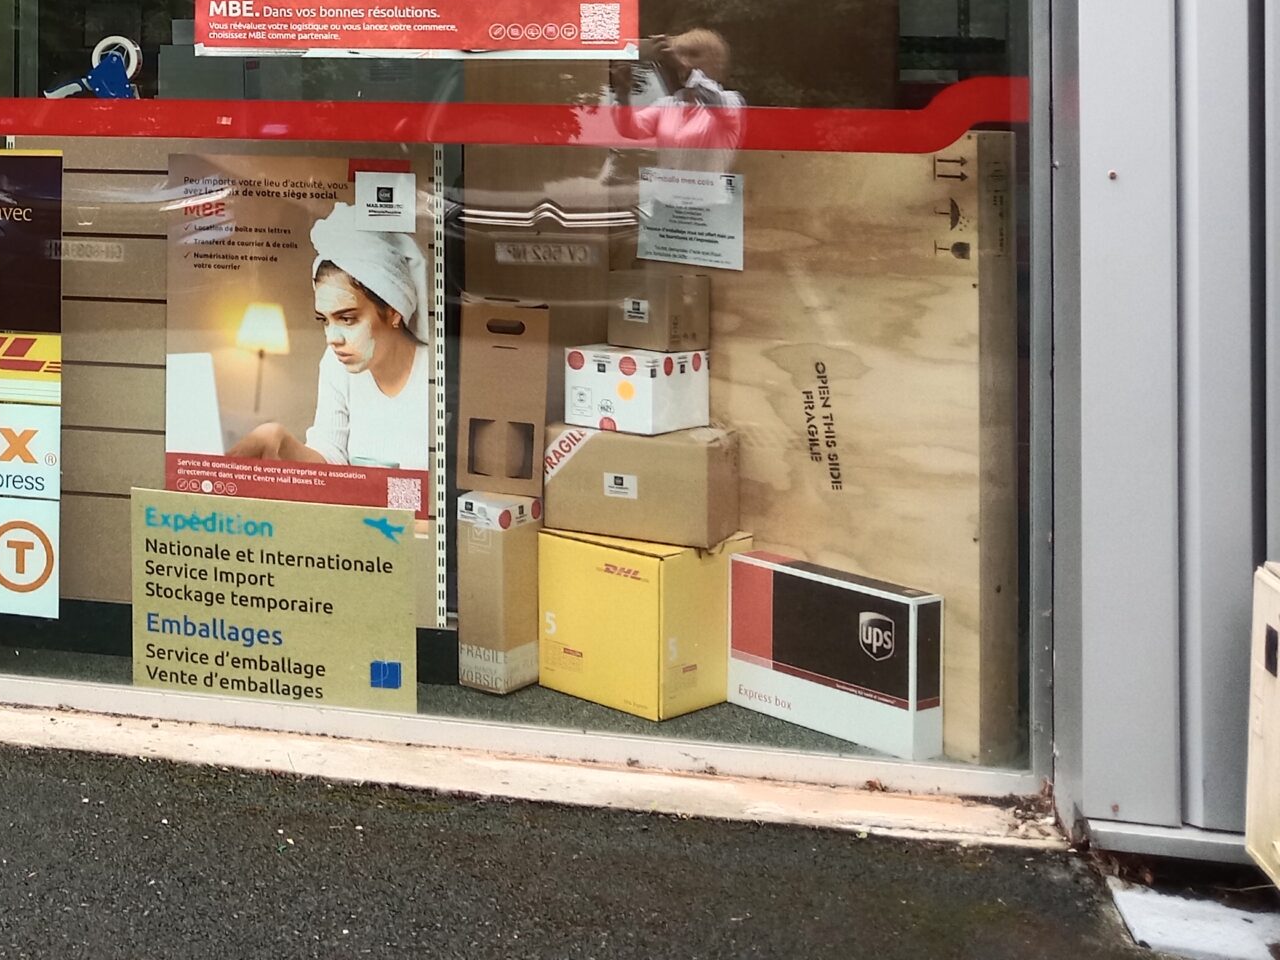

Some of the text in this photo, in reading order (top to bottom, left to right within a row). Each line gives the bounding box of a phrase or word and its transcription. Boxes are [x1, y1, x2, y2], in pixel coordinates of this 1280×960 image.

[209, 1, 440, 18] MBE. Dans vos bonnes résolutions.
[209, 22, 228, 30] Vous
[290, 23, 328, 32] logistique
[209, 31, 247, 39] choisissez
[298, 32, 340, 41] partenaire.
[242, 189, 251, 197] de
[283, 190, 307, 199] siège
[264, 178, 279, 187] lieu
[268, 226, 291, 234] lettres
[194, 252, 238, 261] Numérisation
[270, 254, 277, 262] de
[282, 241, 298, 249] colis
[802, 391, 822, 462] FRAGILE
[815, 362, 842, 490] OPEN THIS SIDE
[145, 538, 393, 573] Nationale et Internationale
[146, 560, 275, 587] Service Import
[146, 581, 333, 614] Stockage temporaire
[147, 613, 282, 647] Emballages
[862, 626, 891, 653] ups
[146, 643, 326, 678] Service d'emballage
[146, 665, 323, 700] Vente d'emballages
[739, 684, 791, 710] Express box
